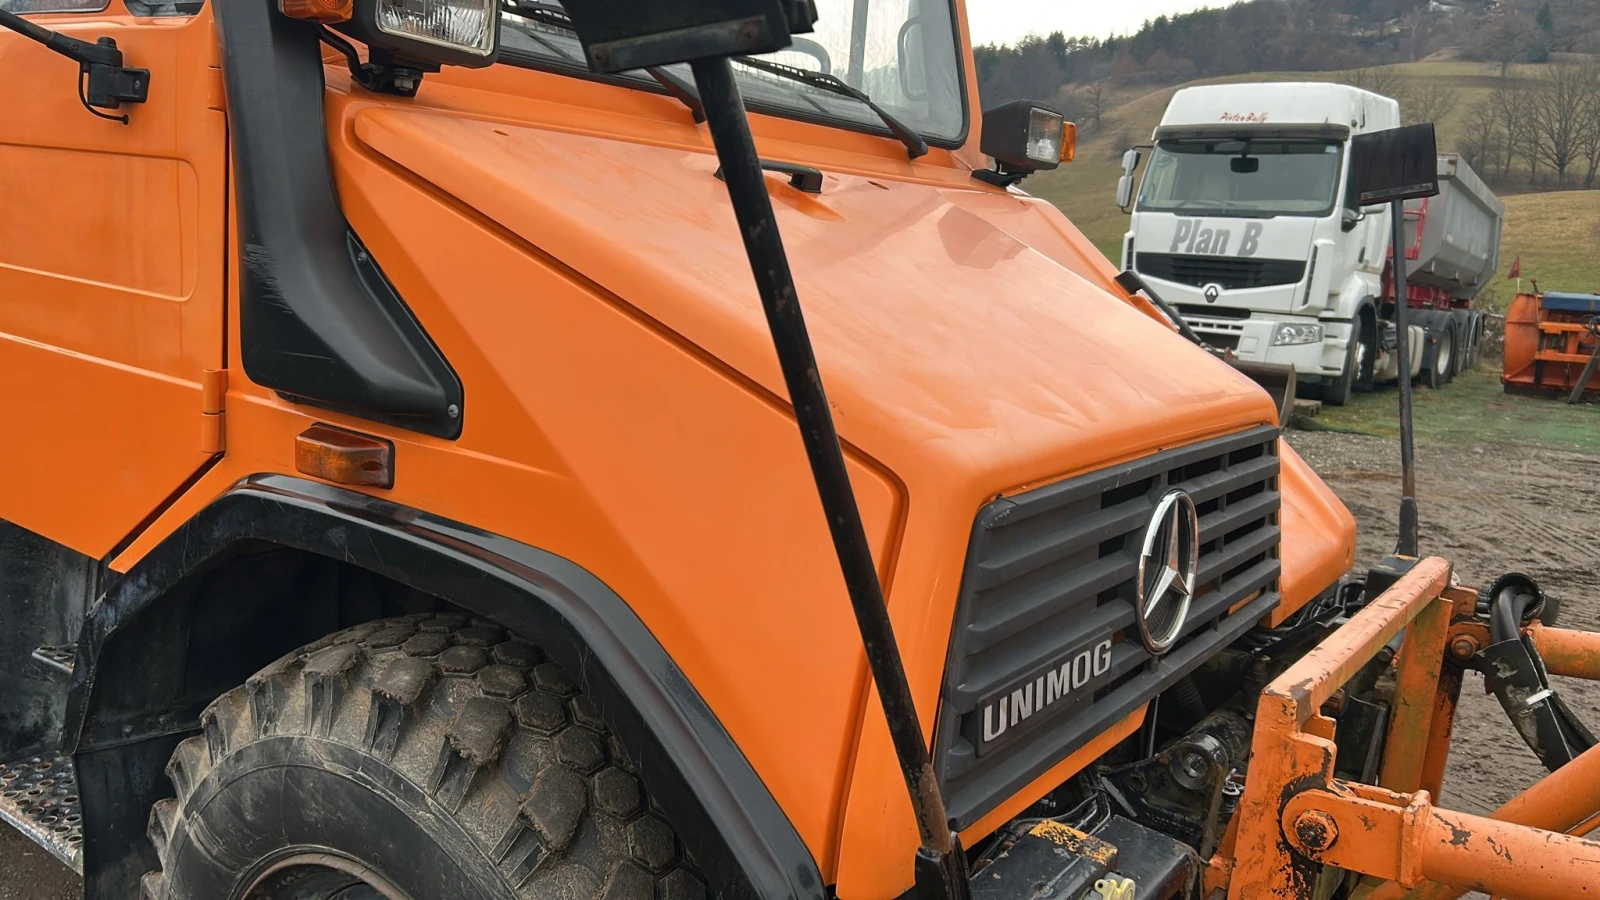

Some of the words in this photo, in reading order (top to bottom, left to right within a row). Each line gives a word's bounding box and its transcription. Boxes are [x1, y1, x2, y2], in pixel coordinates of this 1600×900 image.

[1169, 219, 1231, 255] Plan
[1237, 221, 1263, 257] B
[983, 639, 1112, 742] UNIMOG
